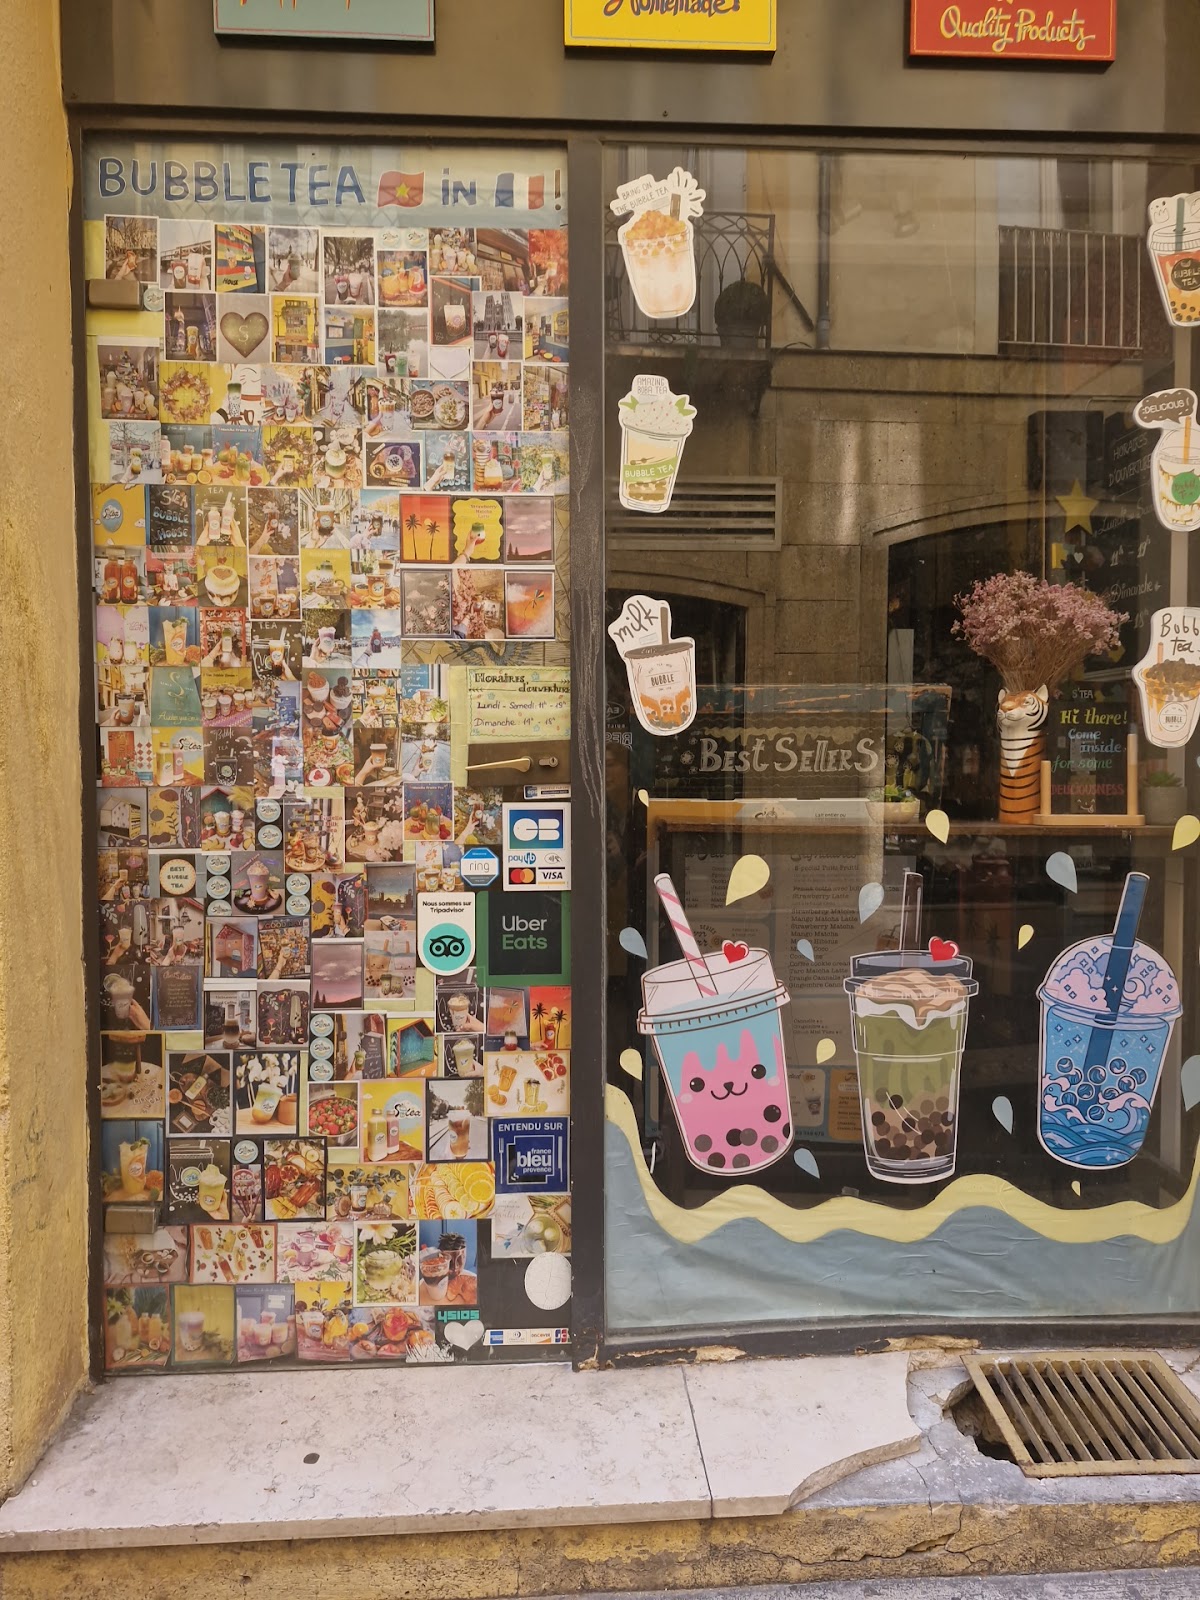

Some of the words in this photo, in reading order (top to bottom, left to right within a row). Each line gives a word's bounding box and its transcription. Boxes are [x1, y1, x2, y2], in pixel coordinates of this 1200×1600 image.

[940, 5, 1014, 52] Quality
[1014, 8, 1096, 50] Products
[99, 157, 272, 205] BUBBLE
[280, 161, 366, 207] TEA
[621, 186, 640, 201] BRING
[642, 181, 653, 191] ON
[615, 204, 628, 215] THE
[629, 192, 655, 209] BUBBLE
[655, 186, 669, 197] TEA
[637, 377, 665, 387] AMAZING
[637, 386, 653, 395] BOBA
[655, 385, 668, 395] TEA
[625, 467, 656, 478] BUBBLE
[658, 464, 674, 475] TEA
[208, 486, 225, 495] TEA
[152, 506, 189, 524] BUBBLE
[156, 528, 189, 541] HOUSE
[613, 600, 659, 643] milk
[650, 673, 675, 687] BUBBLE
[477, 700, 501, 710] Lundi
[1060, 708, 1080, 724] Hi
[1084, 707, 1128, 725] there!
[1068, 728, 1102, 740] Come
[1080, 739, 1122, 753] inside
[1052, 755, 1074, 774] for
[1078, 758, 1113, 769] some
[1050, 783, 1125, 796] DELICIOUSNESS
[469, 861, 490, 874] ring
[541, 872, 564, 880] VISA
[502, 915, 548, 932] Uber
[502, 933, 548, 950] Eats
[498, 1122, 541, 1132] ENTENDU
[543, 1122, 563, 1130] SUR
[517, 1151, 552, 1167] bleu
